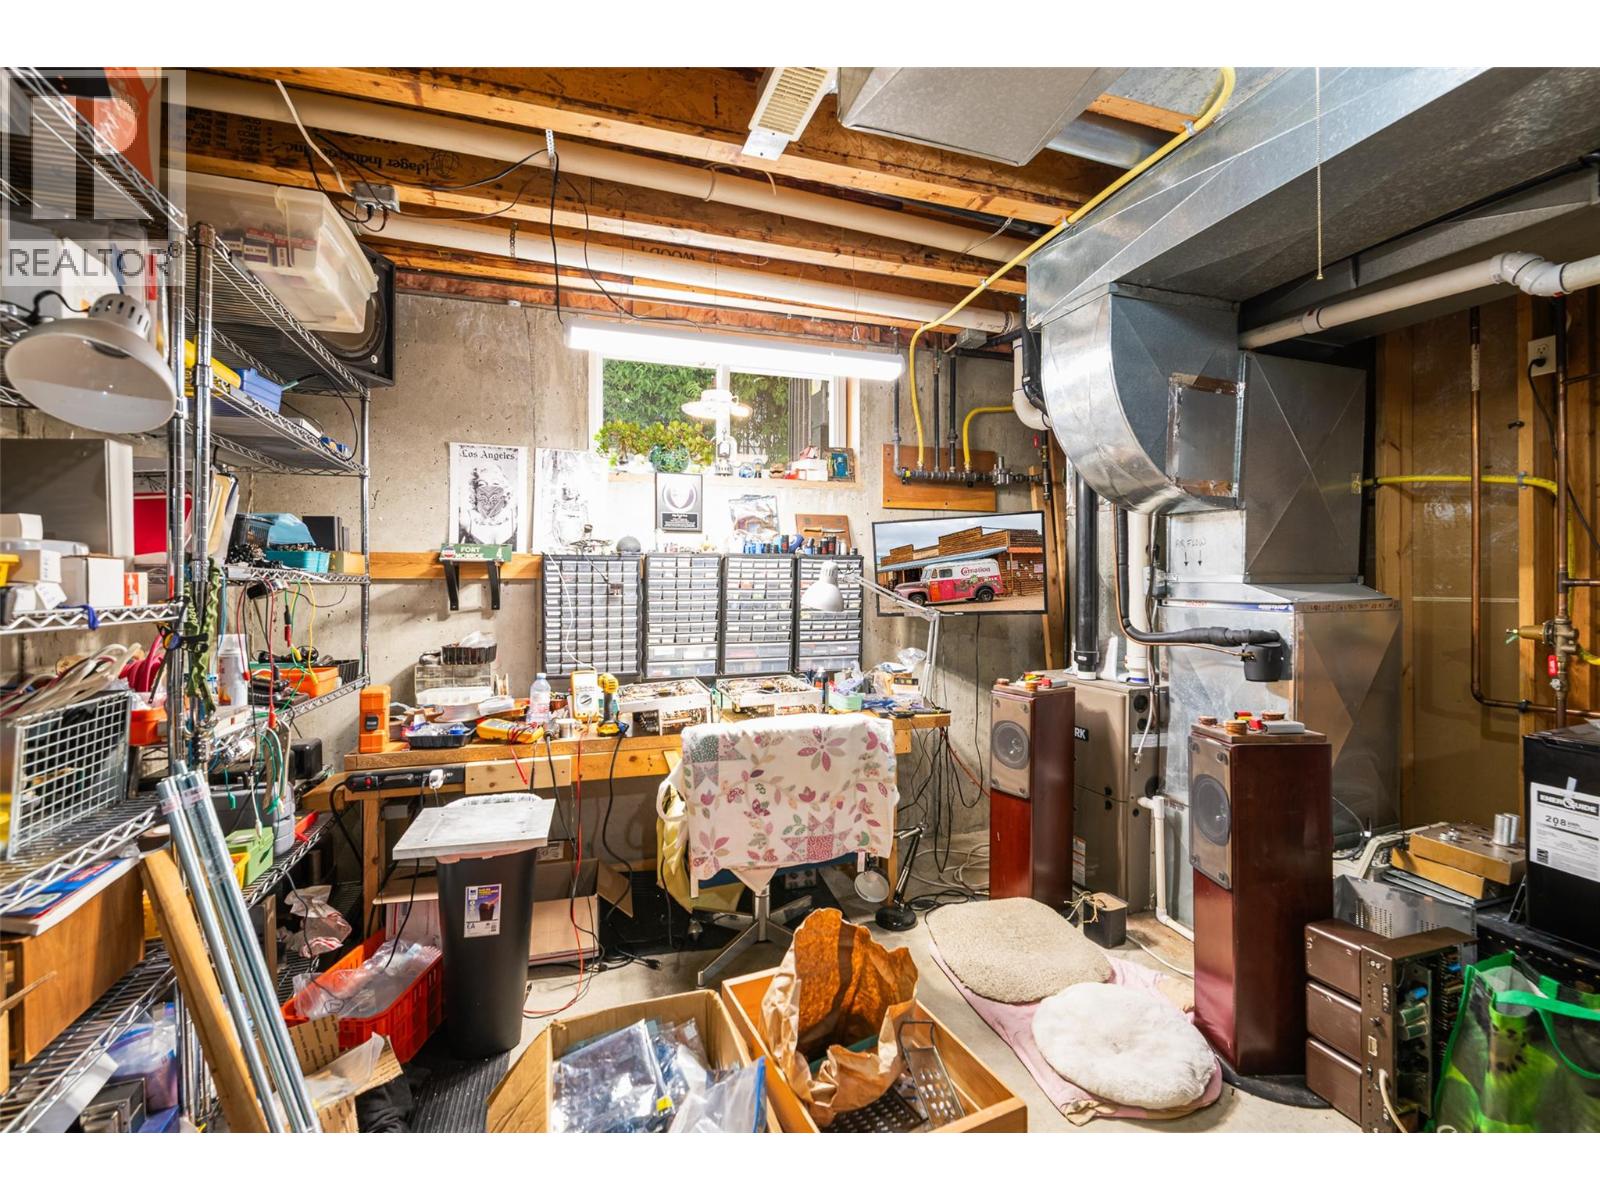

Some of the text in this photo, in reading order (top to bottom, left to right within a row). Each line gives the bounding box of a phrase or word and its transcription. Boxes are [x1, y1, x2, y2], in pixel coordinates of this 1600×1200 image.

[460, 448, 516, 461] Los Angeles
[1074, 726, 1087, 740] RK
[1545, 814, 1567, 827] 208
